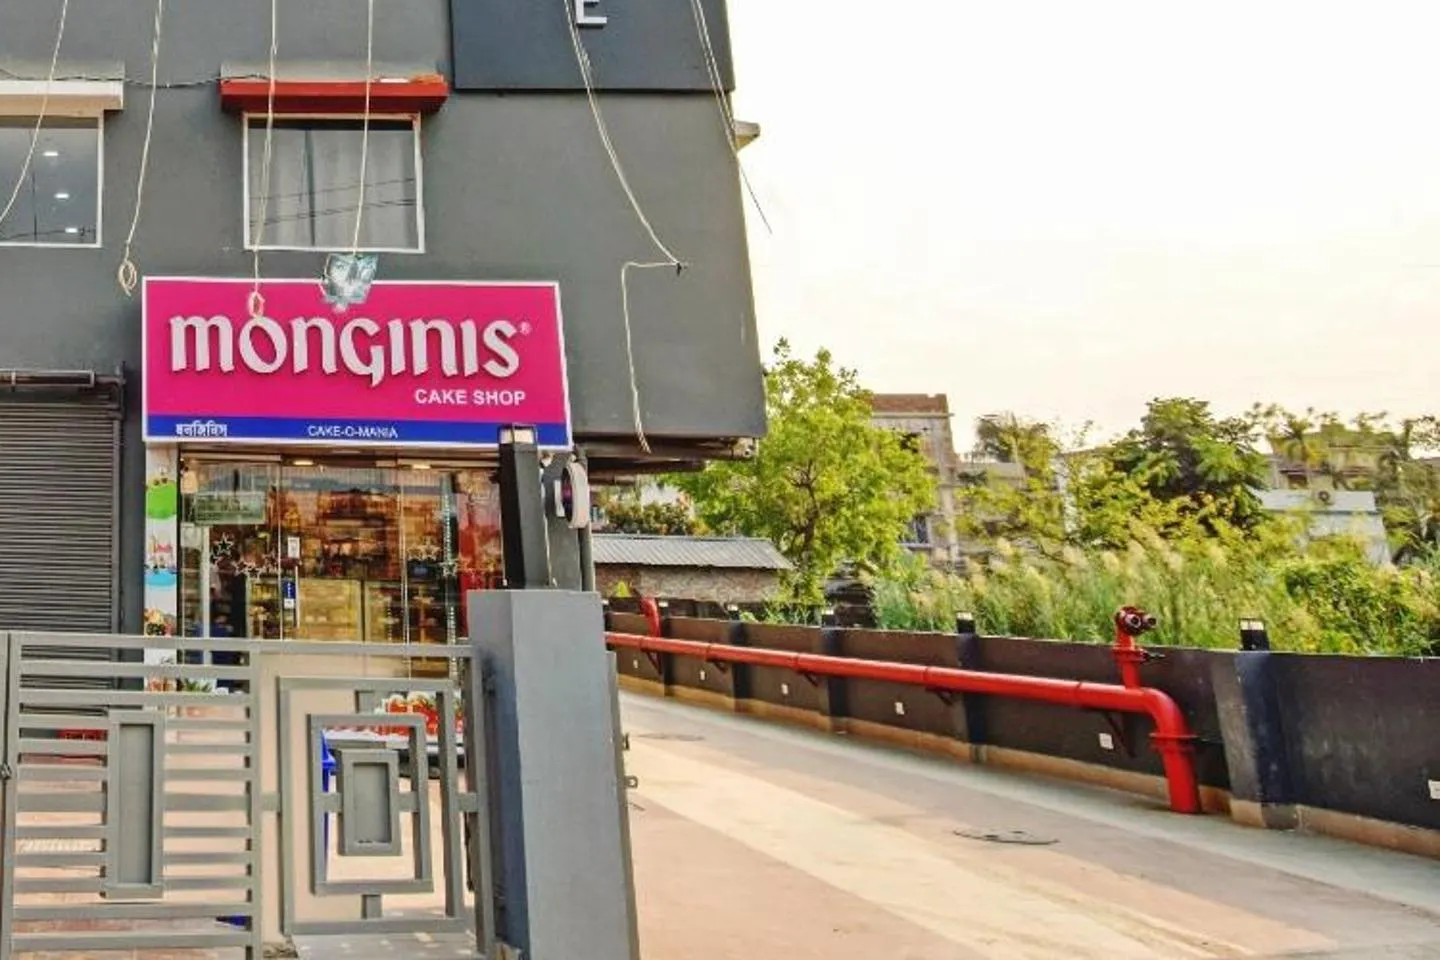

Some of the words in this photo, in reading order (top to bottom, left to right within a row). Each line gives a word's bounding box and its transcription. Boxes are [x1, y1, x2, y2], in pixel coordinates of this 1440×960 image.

[415, 388, 467, 406] CAKE
[472, 389, 527, 407] SHOP
[308, 425, 398, 439] CAKE-O-MANIA
